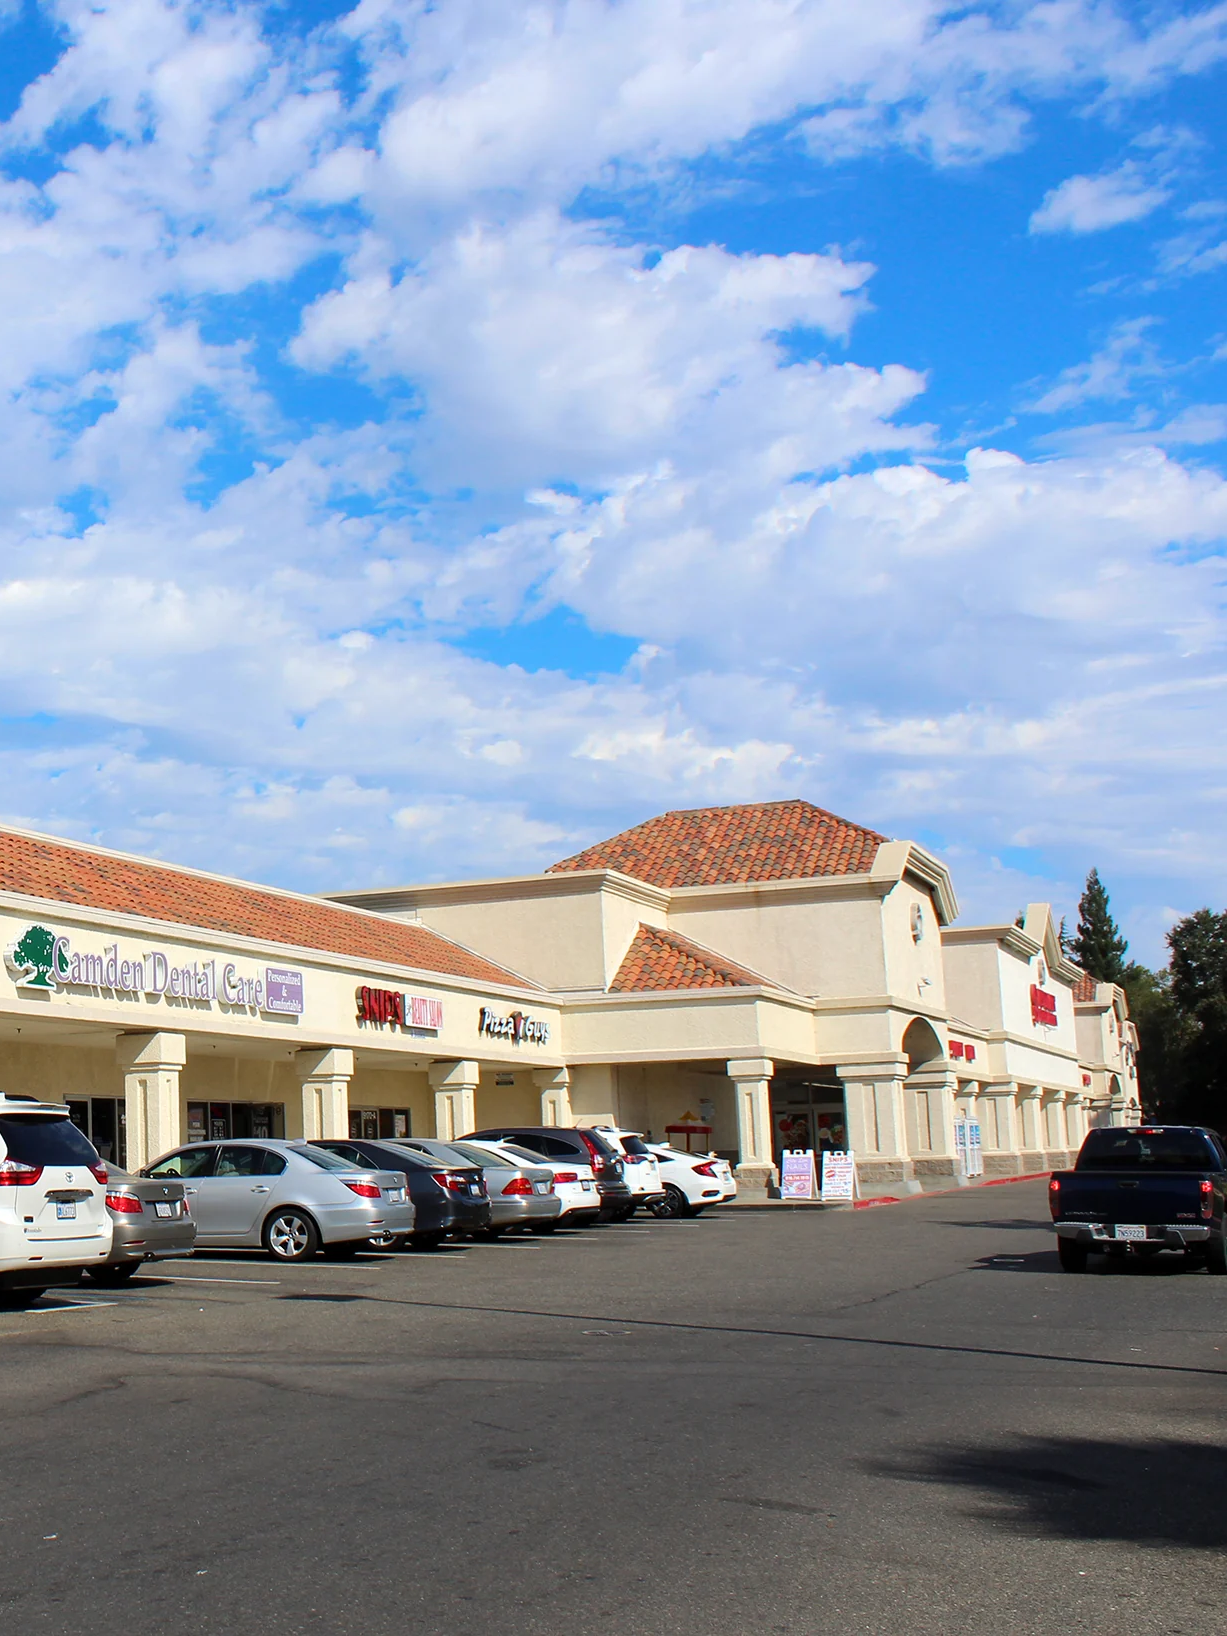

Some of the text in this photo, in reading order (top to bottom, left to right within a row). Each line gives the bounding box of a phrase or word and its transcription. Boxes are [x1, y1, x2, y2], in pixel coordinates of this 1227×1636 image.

[53, 936, 263, 1006] Camden Dental Care
[267, 969, 301, 986] Personalized
[280, 984, 288, 997] &
[268, 996, 302, 1013] Comfortable
[359, 985, 403, 1026] SNIPS
[480, 1006, 551, 1041] Pizza Guys
